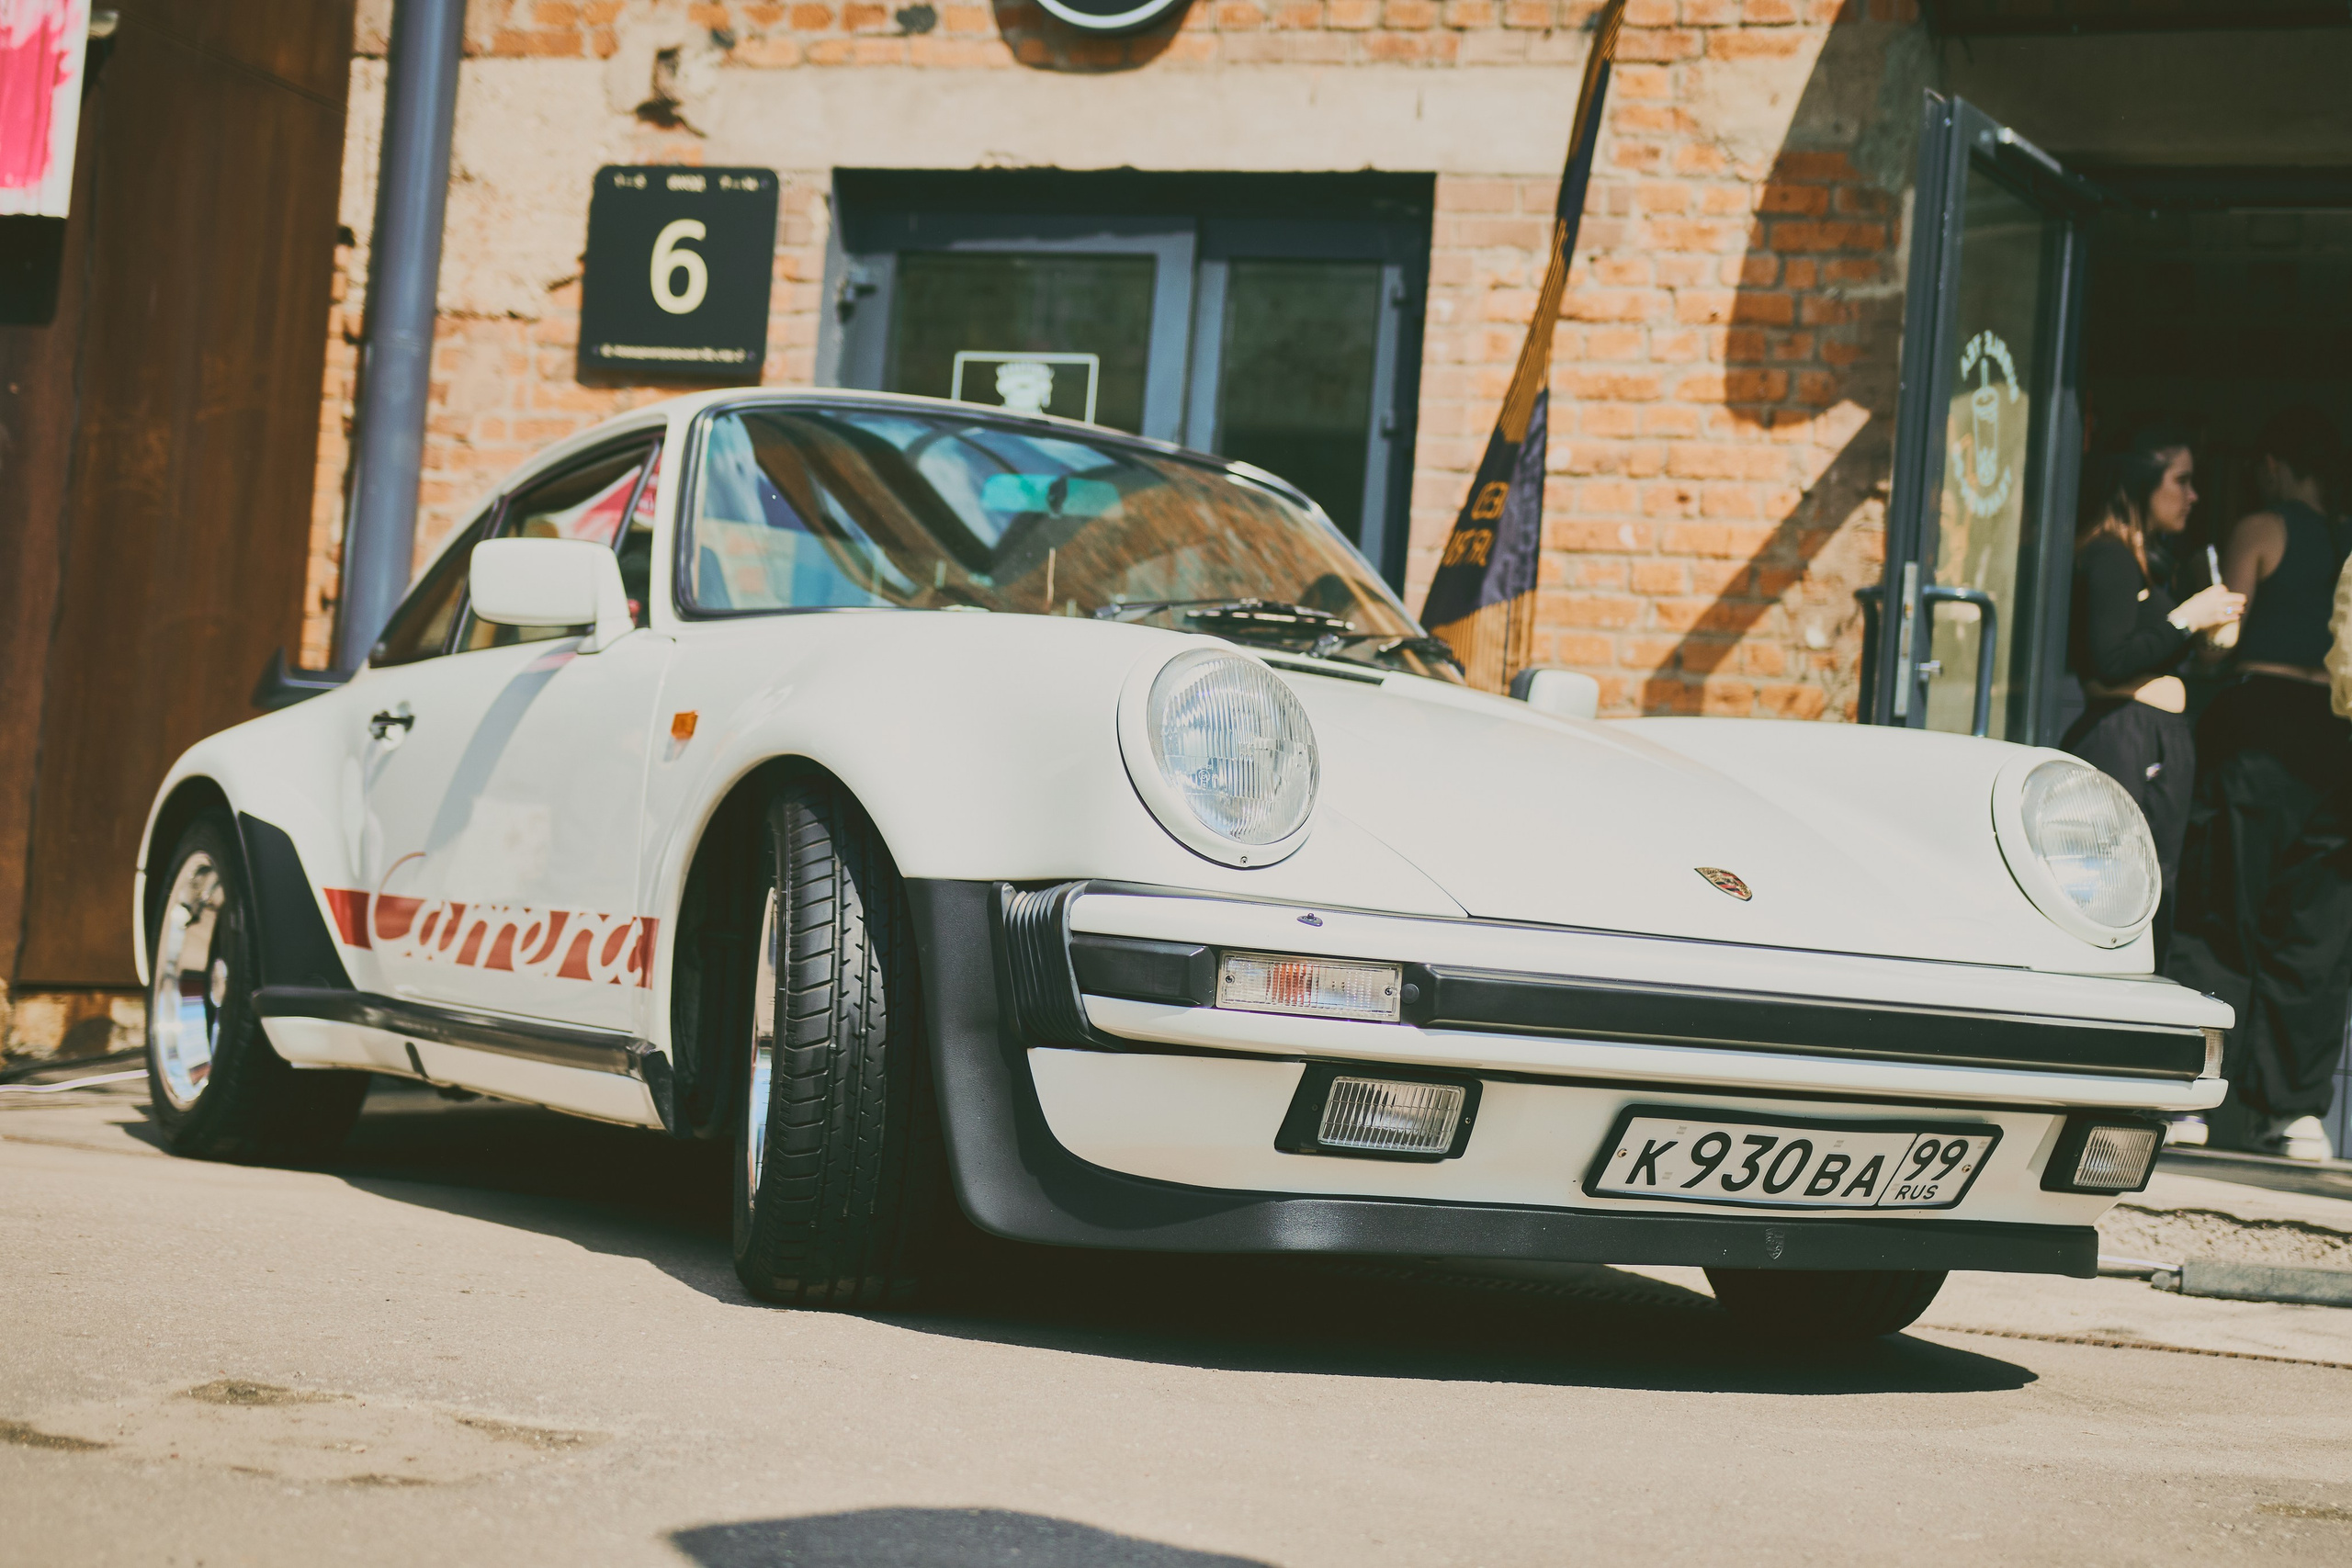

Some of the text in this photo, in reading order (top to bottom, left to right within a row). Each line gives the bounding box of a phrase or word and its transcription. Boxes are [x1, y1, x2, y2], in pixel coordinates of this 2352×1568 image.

[650, 218, 708, 315] 6
[367, 852, 645, 987] Carrera
[1894, 1184, 1939, 1201] RUS
[1904, 1139, 1969, 1181] 99
